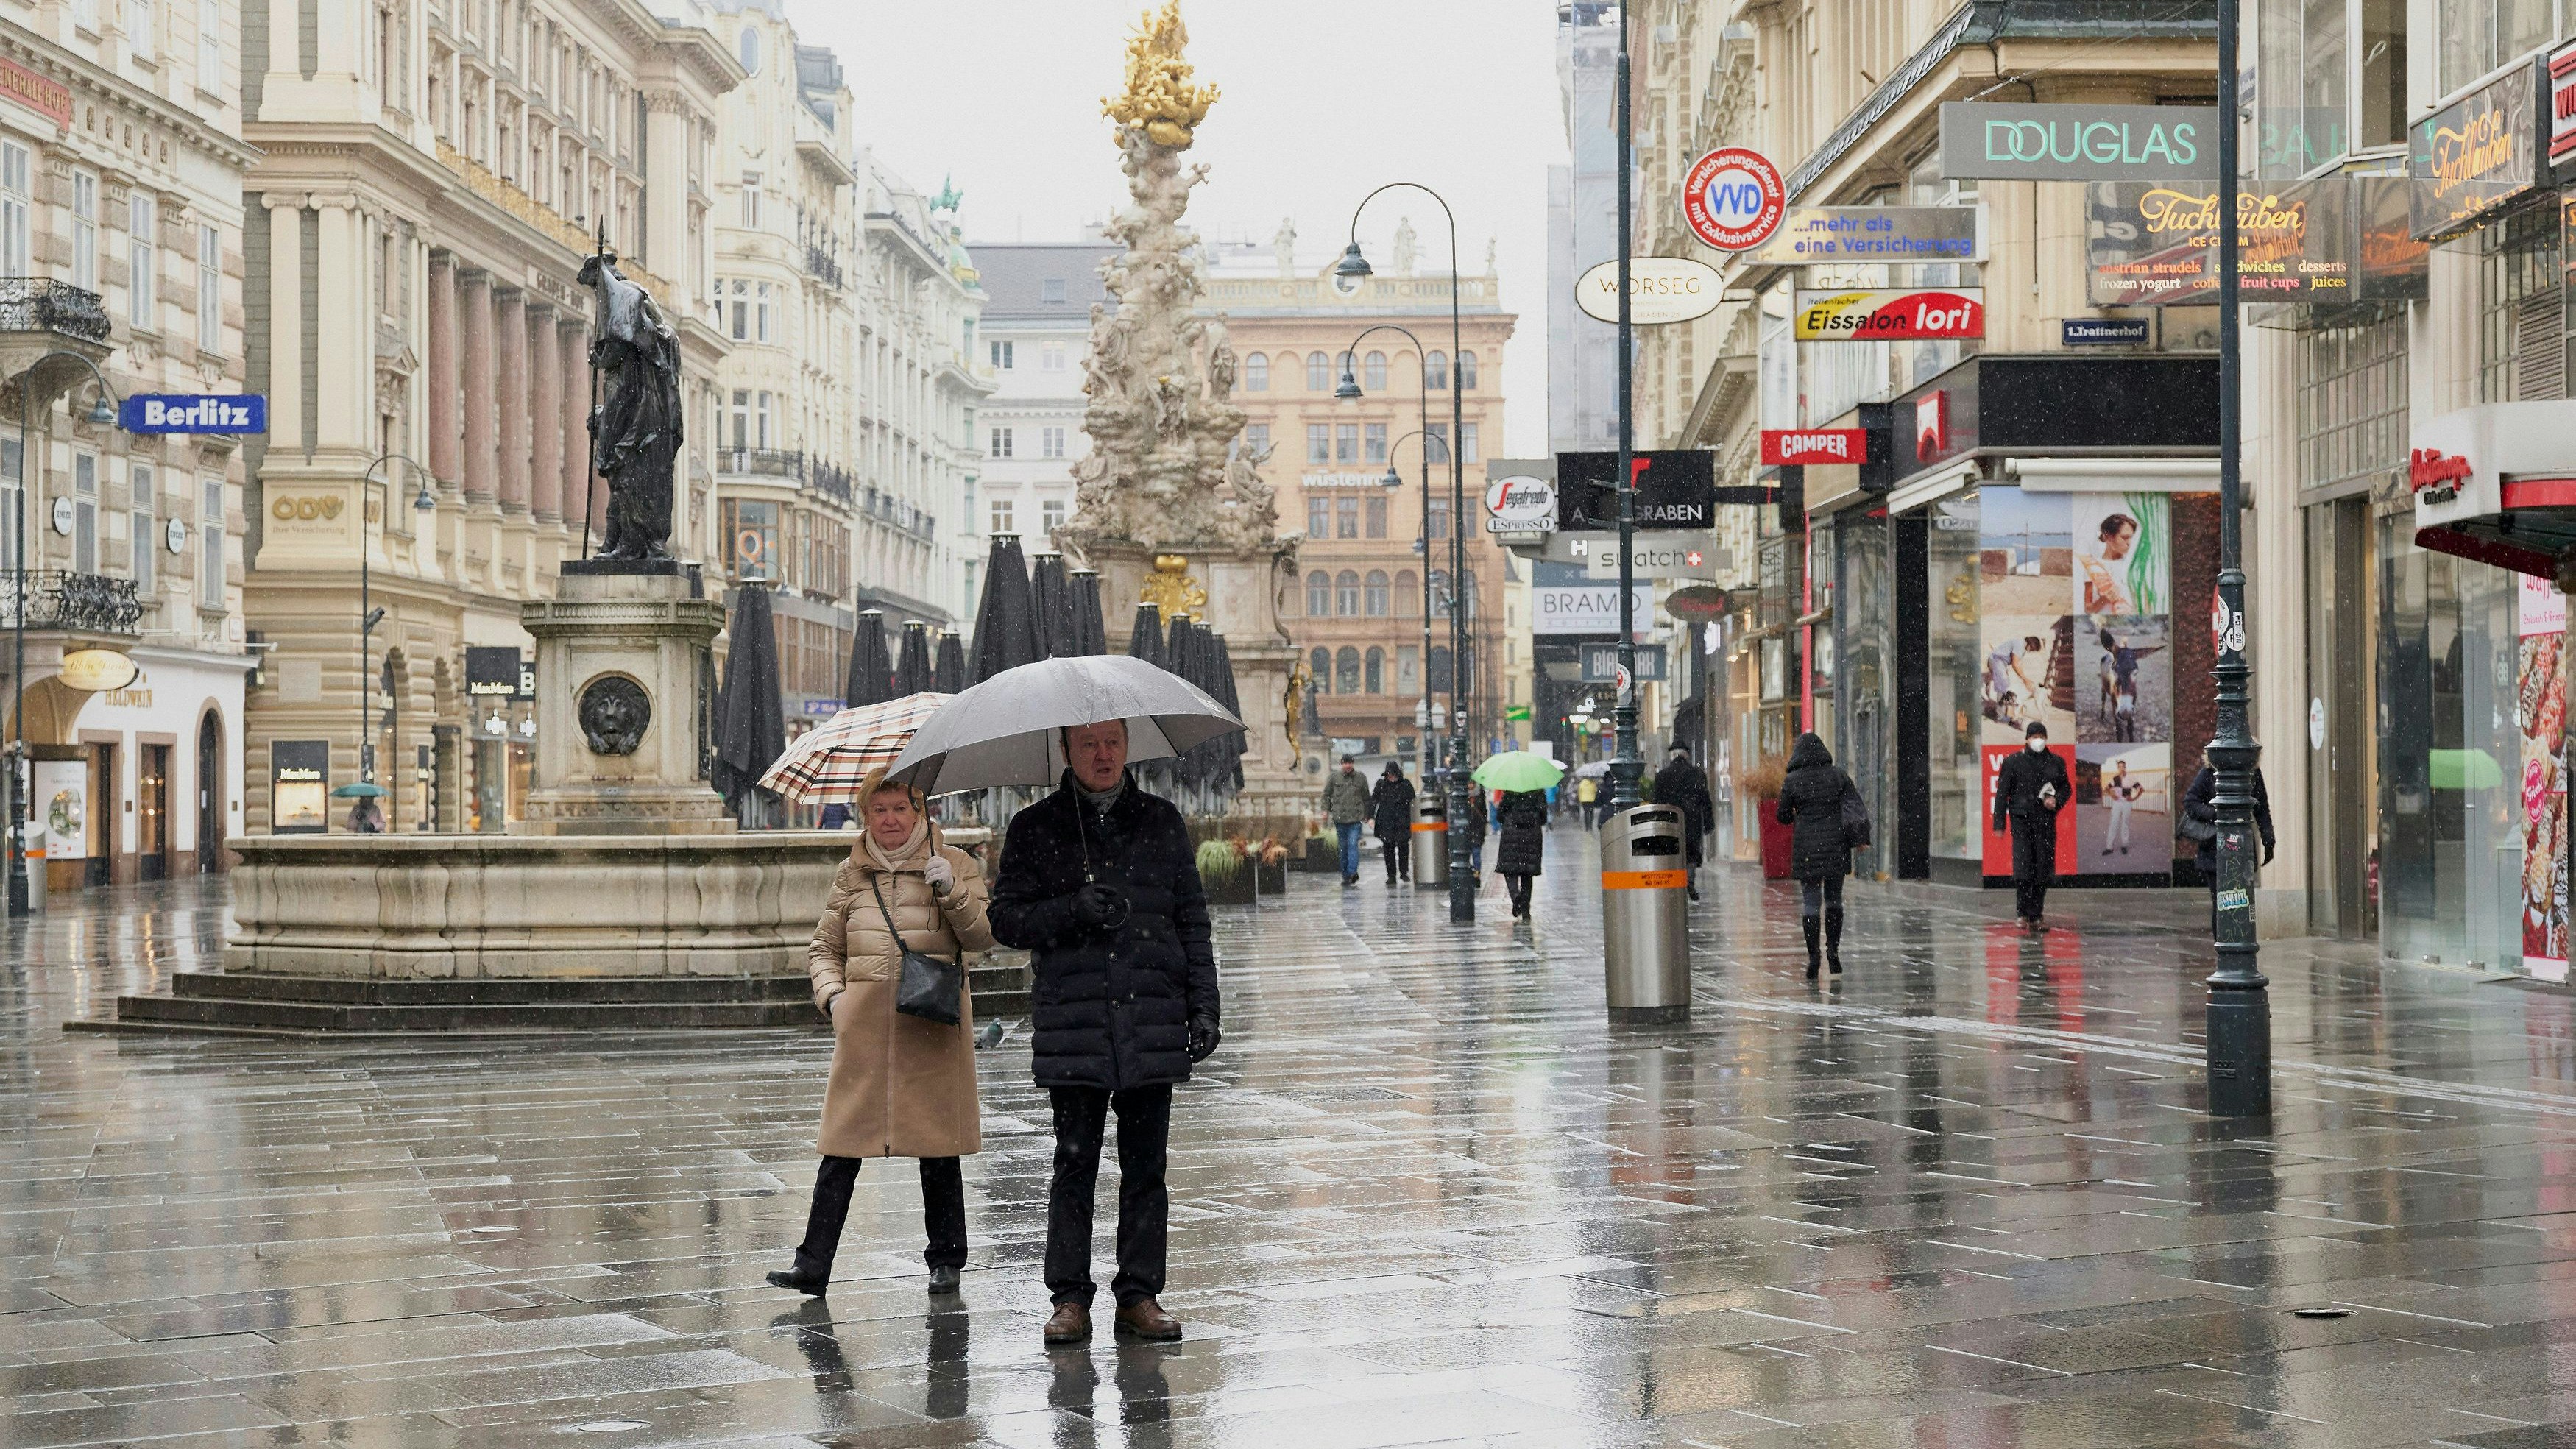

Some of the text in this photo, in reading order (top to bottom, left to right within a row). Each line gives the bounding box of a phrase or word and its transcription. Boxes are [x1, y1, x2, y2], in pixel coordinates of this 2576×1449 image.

[1986, 120, 2197, 165] DOUGLAS
[1689, 155, 1780, 198] Versicherungsdienst
[1711, 183, 1760, 214] VVD
[1691, 202, 1777, 244] mit Exklusivservice
[1866, 216, 1893, 232] als
[1795, 236, 1972, 255] eine Versicherung
[2189, 237, 2206, 247] ICE
[2099, 259, 2347, 274] austrian strudels sdwiches desserts
[2100, 278, 2137, 289] frozen
[2140, 278, 2181, 292] yogurt
[2241, 275, 2268, 288] fruit
[2271, 277, 2300, 291] cups
[2310, 276, 2346, 291] juices
[1808, 311, 1906, 330] Eissalon
[145, 398, 250, 426] Berlitz
[1781, 434, 1847, 458] CAMPER
[1493, 483, 1548, 510] Segafredo
[1493, 520, 1549, 530] ESPRESSO
[471, 682, 514, 694] MaxMara
[105, 689, 152, 708] HELDWEIN
